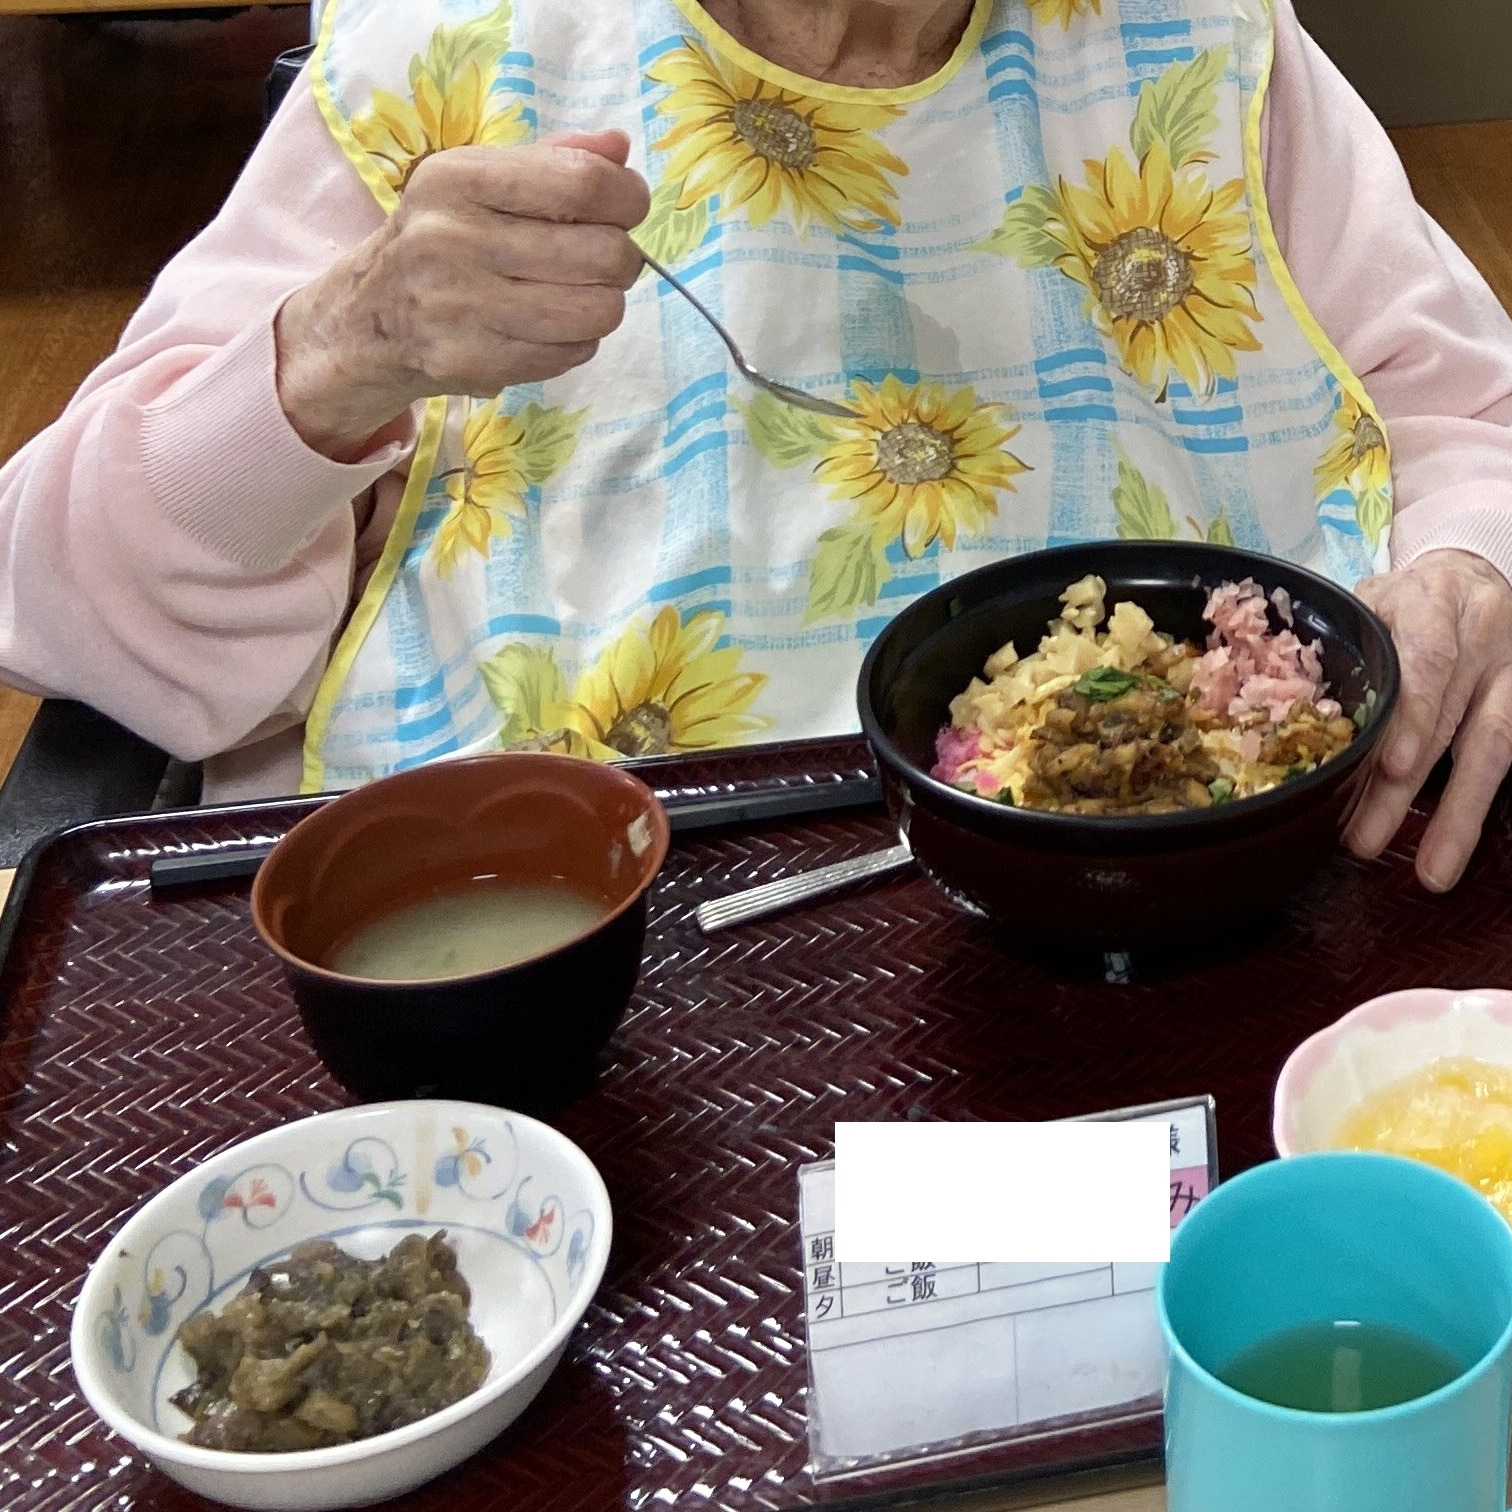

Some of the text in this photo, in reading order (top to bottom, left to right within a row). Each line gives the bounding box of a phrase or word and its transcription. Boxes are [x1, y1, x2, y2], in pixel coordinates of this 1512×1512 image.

[811, 1236, 833, 1260] 朝
[813, 1265, 835, 1290] 昼
[887, 1273, 937, 1304] ご飯
